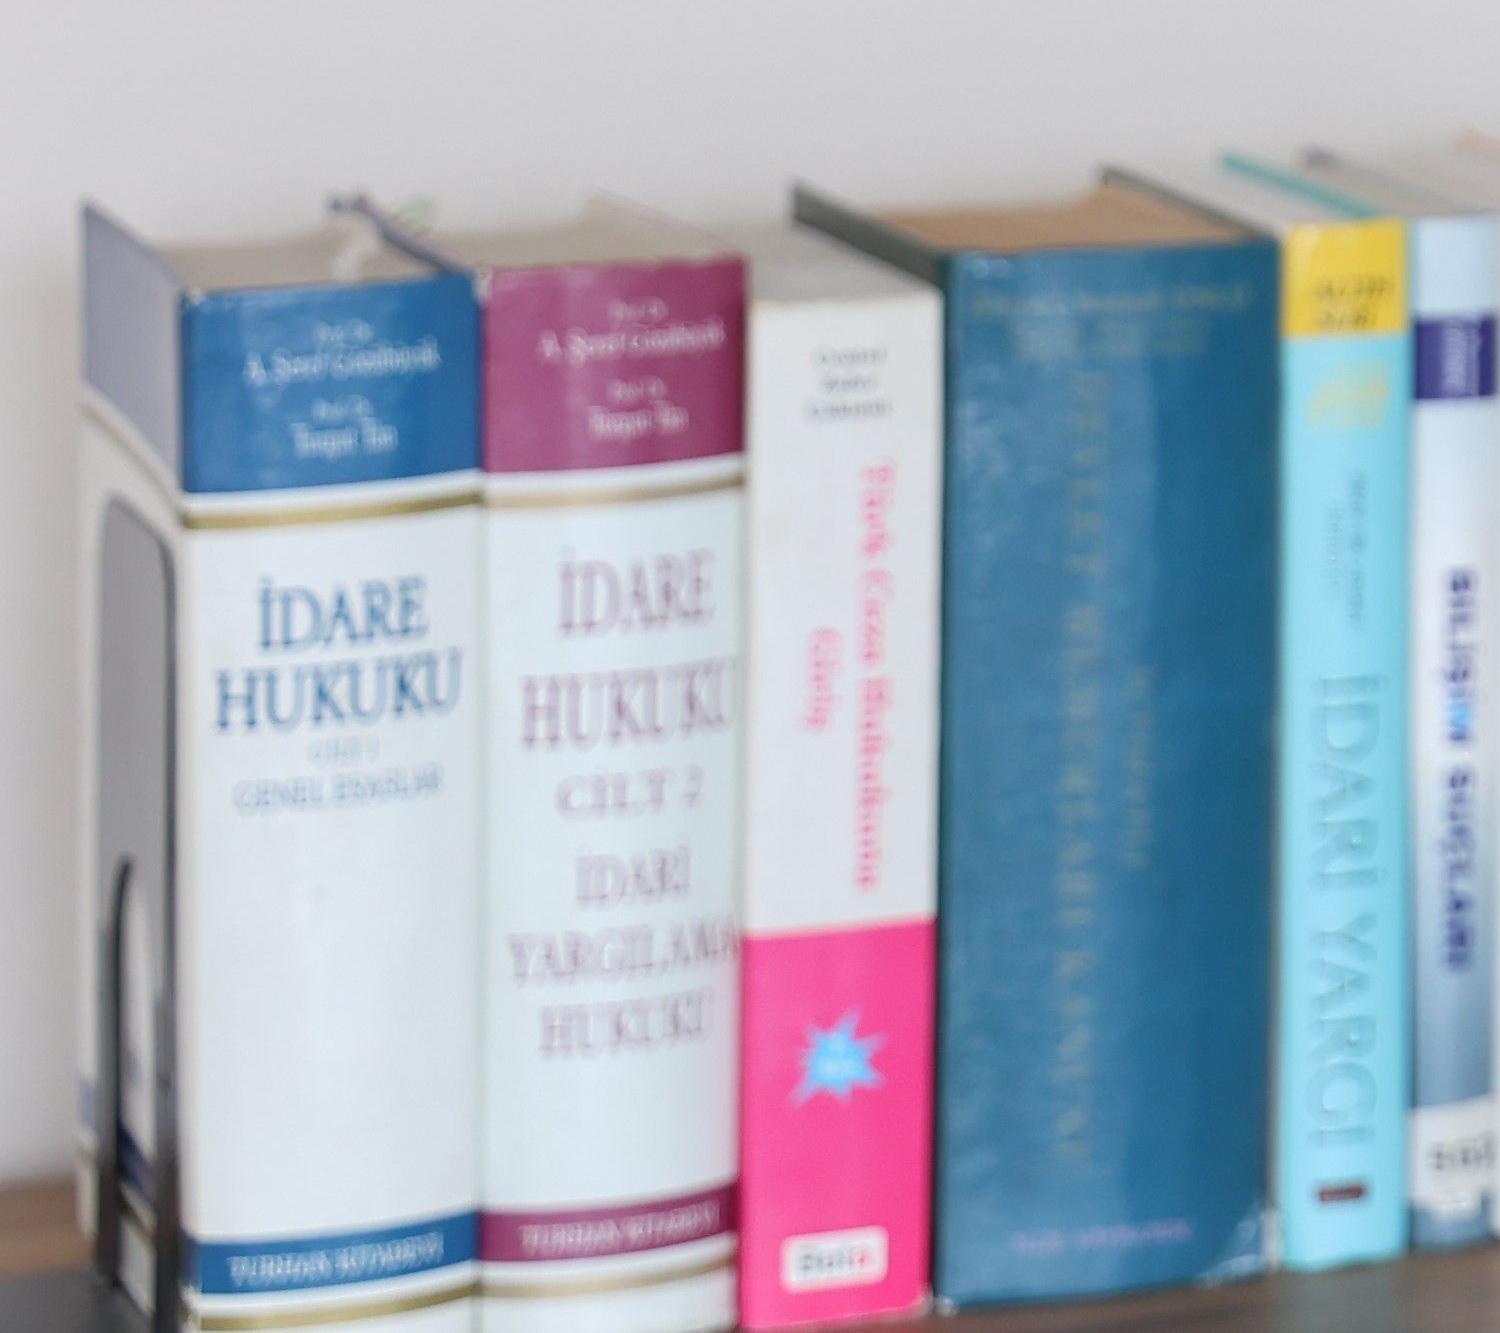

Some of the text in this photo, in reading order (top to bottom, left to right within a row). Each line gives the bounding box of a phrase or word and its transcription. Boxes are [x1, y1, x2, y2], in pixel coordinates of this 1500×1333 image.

[261, 576, 429, 650] İDARE
[557, 546, 715, 635] İDARE
[214, 647, 462, 733] HUKUKU
[1306, 673, 1384, 887] İDARİ
[538, 986, 714, 1057] HUKUKU
[1305, 909, 1378, 1149] YARGI
